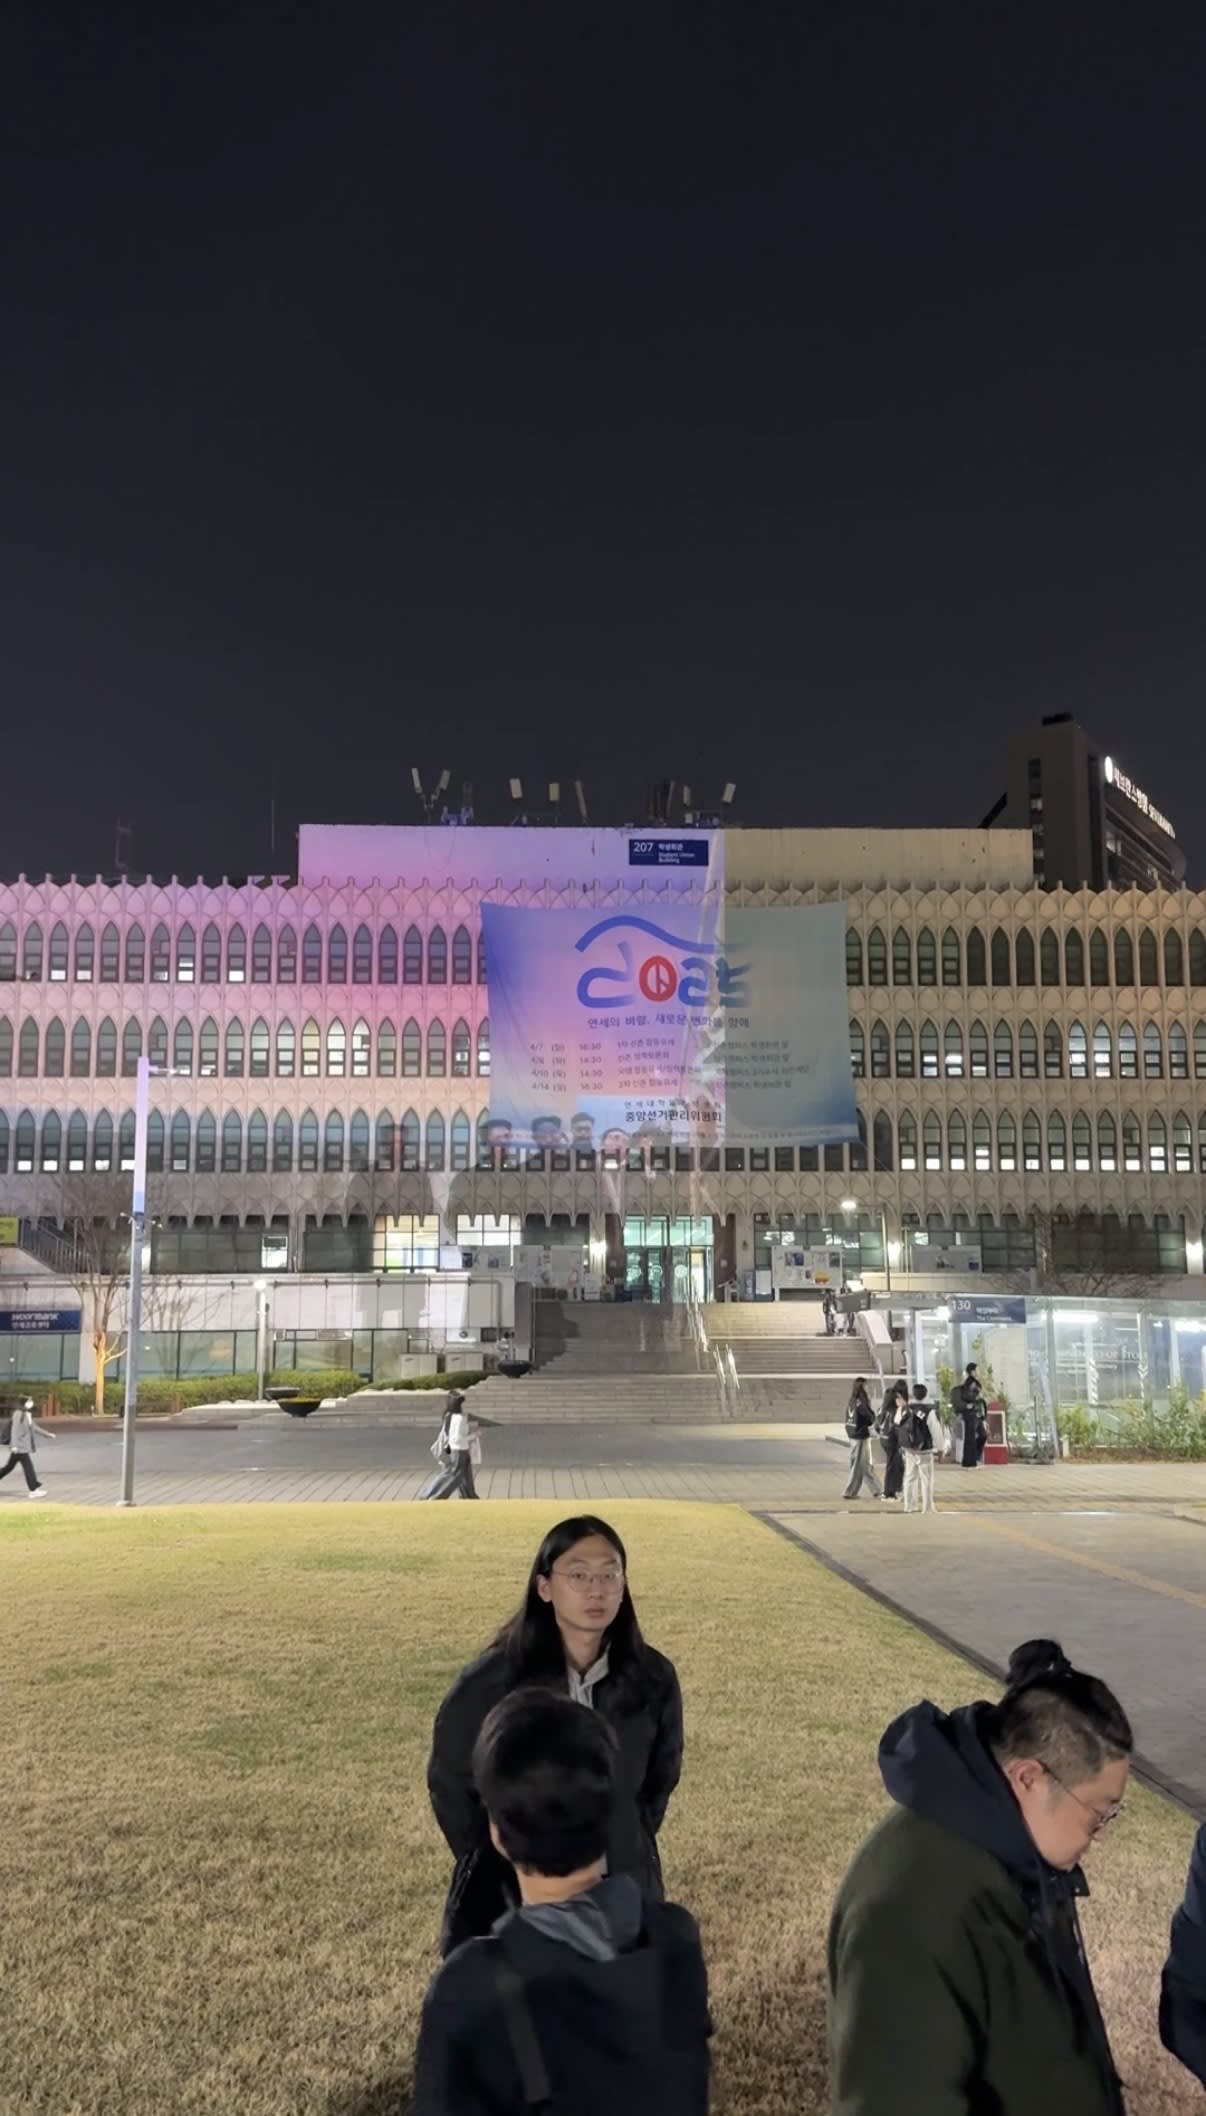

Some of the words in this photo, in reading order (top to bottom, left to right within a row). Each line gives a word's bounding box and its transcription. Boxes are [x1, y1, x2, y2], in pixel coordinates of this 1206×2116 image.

[633, 842, 655, 852] 207
[587, 1015, 620, 1029] 연세의
[656, 1013, 687, 1026] 새로운
[625, 1110, 722, 1122] 중앙선거관리위원회
[951, 1300, 971, 1311] 130
